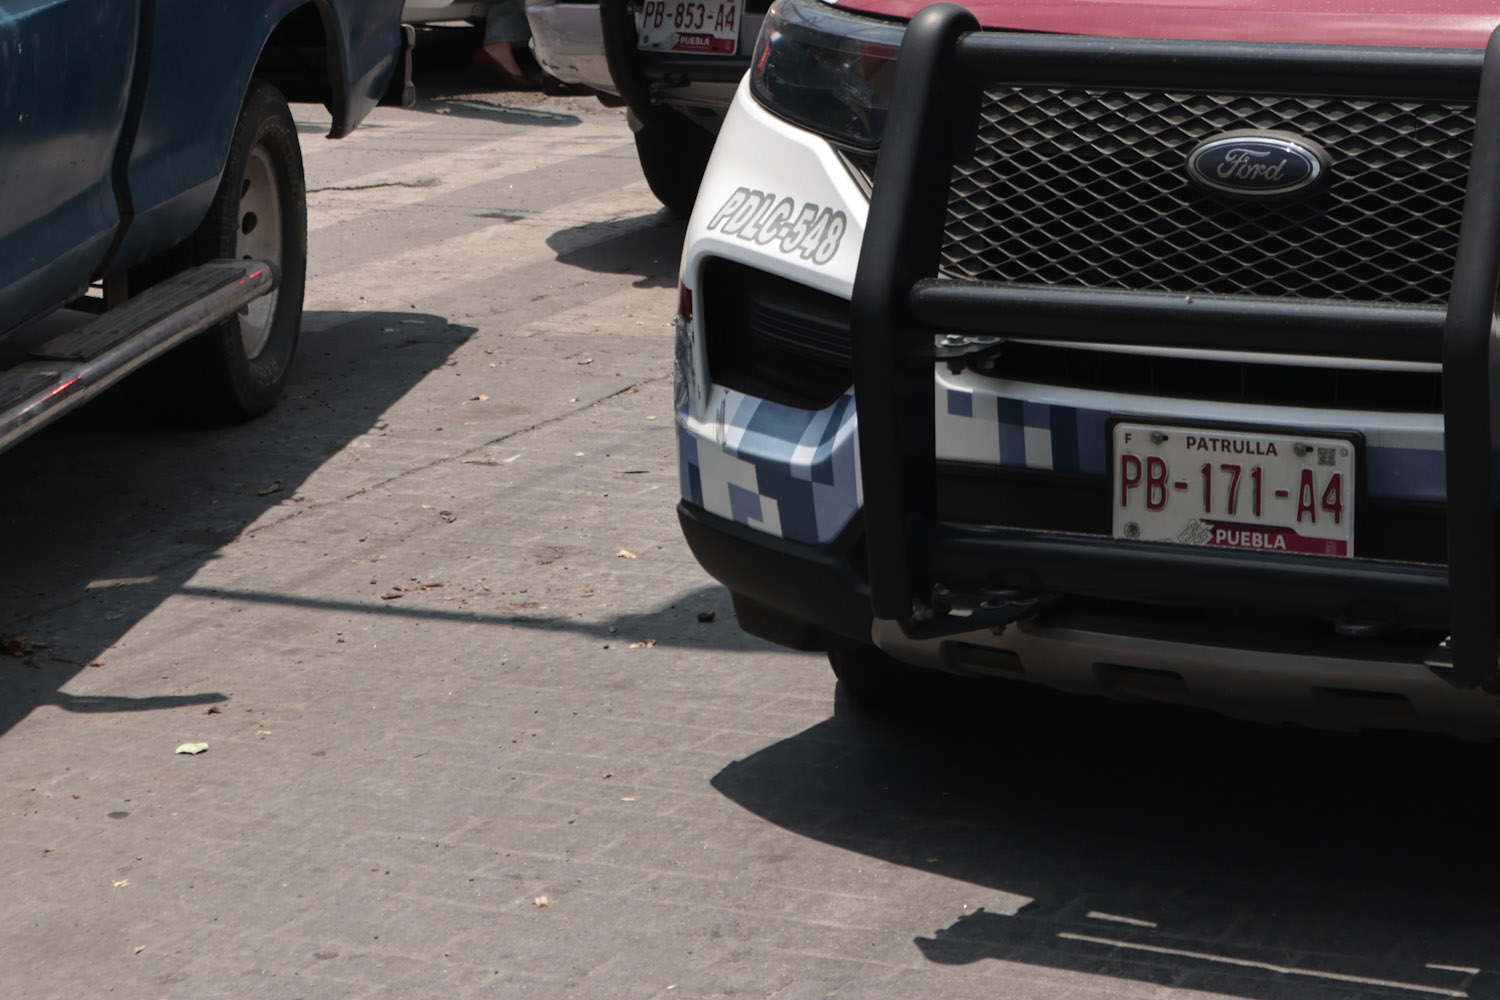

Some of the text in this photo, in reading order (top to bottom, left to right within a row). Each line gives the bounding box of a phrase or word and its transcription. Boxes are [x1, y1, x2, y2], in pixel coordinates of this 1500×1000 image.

[643, 0, 736, 32] PB-853-A4
[680, 35, 710, 46] PUEBLA
[1217, 148, 1287, 181] Ford
[707, 187, 847, 265] PDLC-548
[1125, 433, 1278, 456] F PATRULLA
[1121, 455, 1343, 525] PB-171-A4
[1216, 528, 1286, 550] PUEBLA
